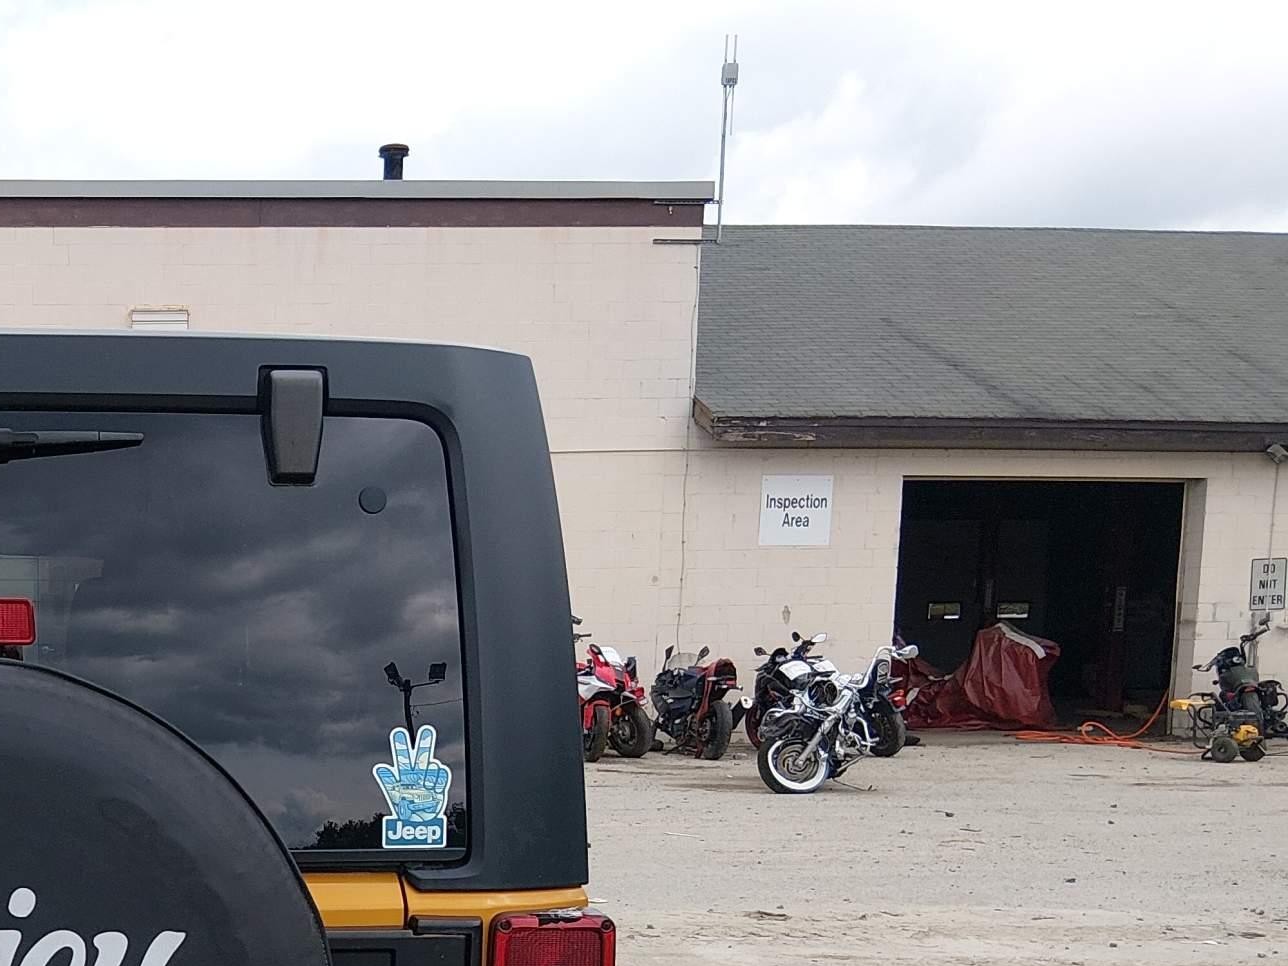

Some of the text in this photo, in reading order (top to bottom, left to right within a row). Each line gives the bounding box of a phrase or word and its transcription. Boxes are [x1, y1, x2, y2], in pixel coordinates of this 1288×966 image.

[765, 493, 828, 512] Inspection
[781, 512, 810, 528] Area
[1263, 563, 1276, 574] DO
[387, 821, 441, 843] Jeep
